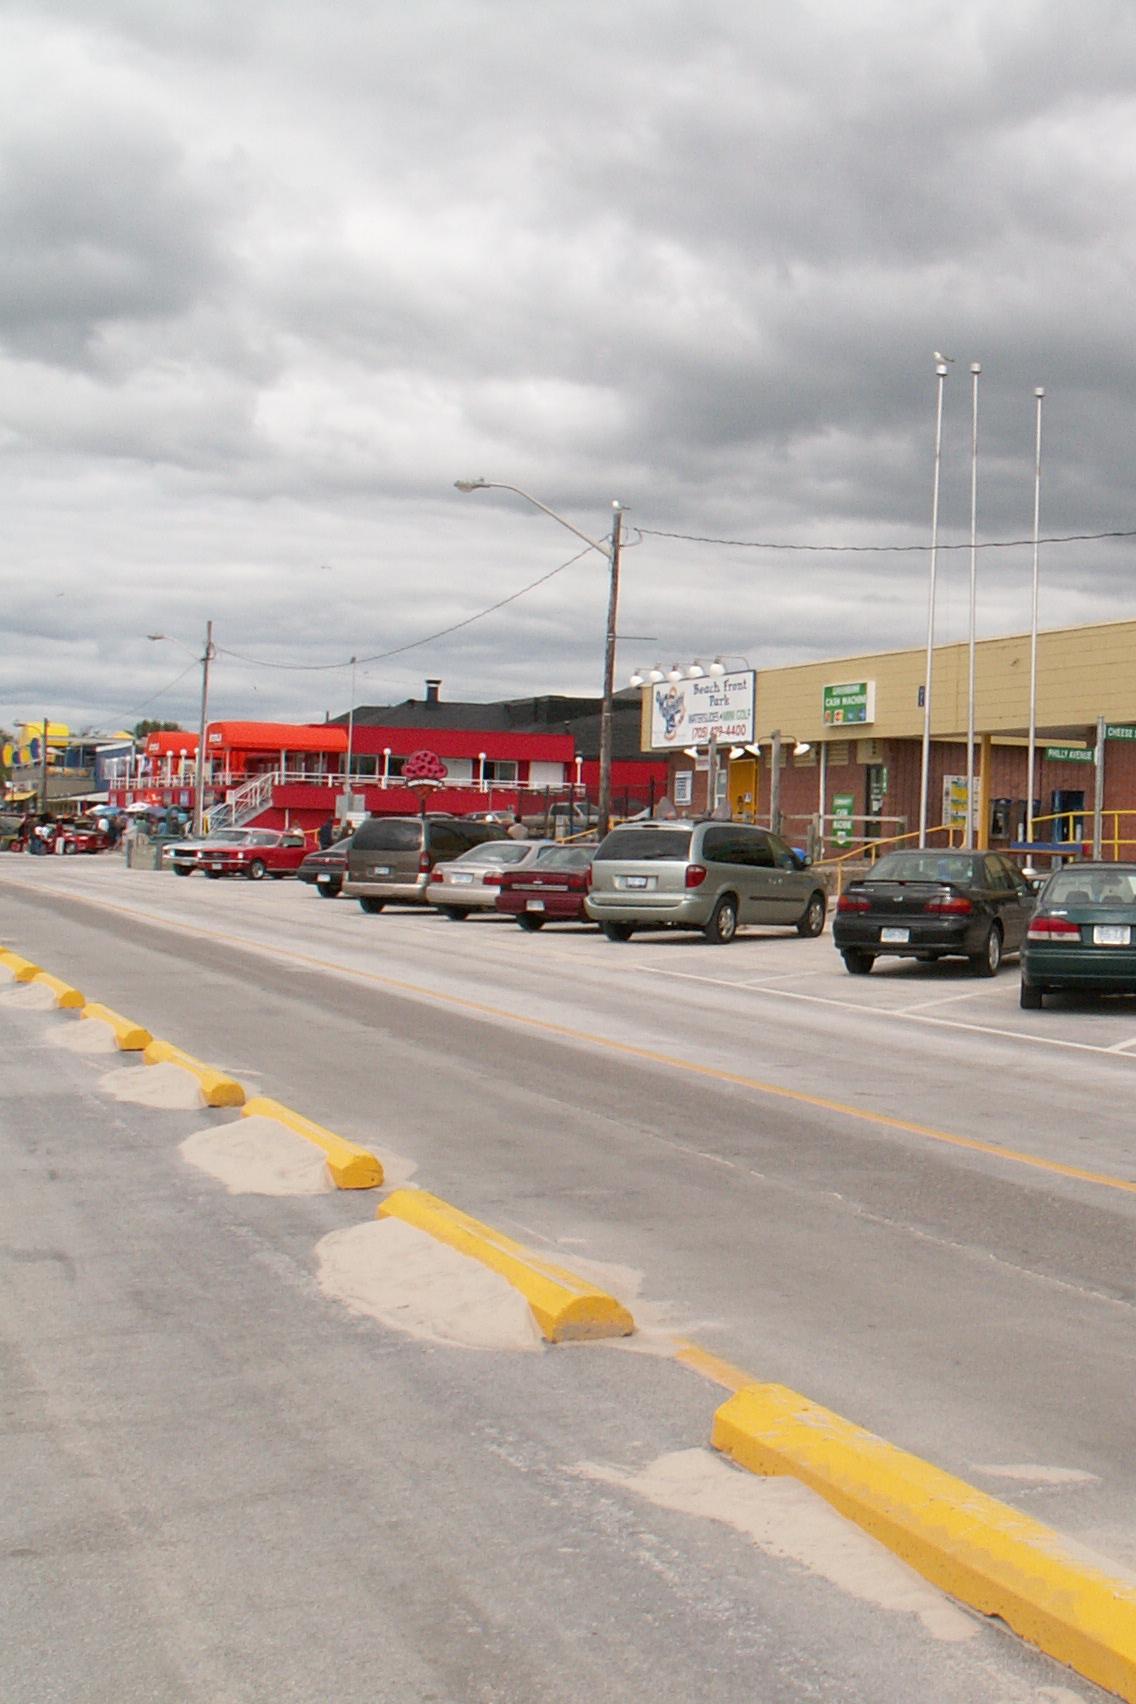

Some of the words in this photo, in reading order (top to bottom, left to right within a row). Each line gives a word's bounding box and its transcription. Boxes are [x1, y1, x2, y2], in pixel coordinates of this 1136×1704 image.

[693, 681, 720, 695] Beach
[709, 694, 730, 707] Park
[1107, 728, 1133, 738] CHEESE
[1047, 748, 1069, 758] PHILLY
